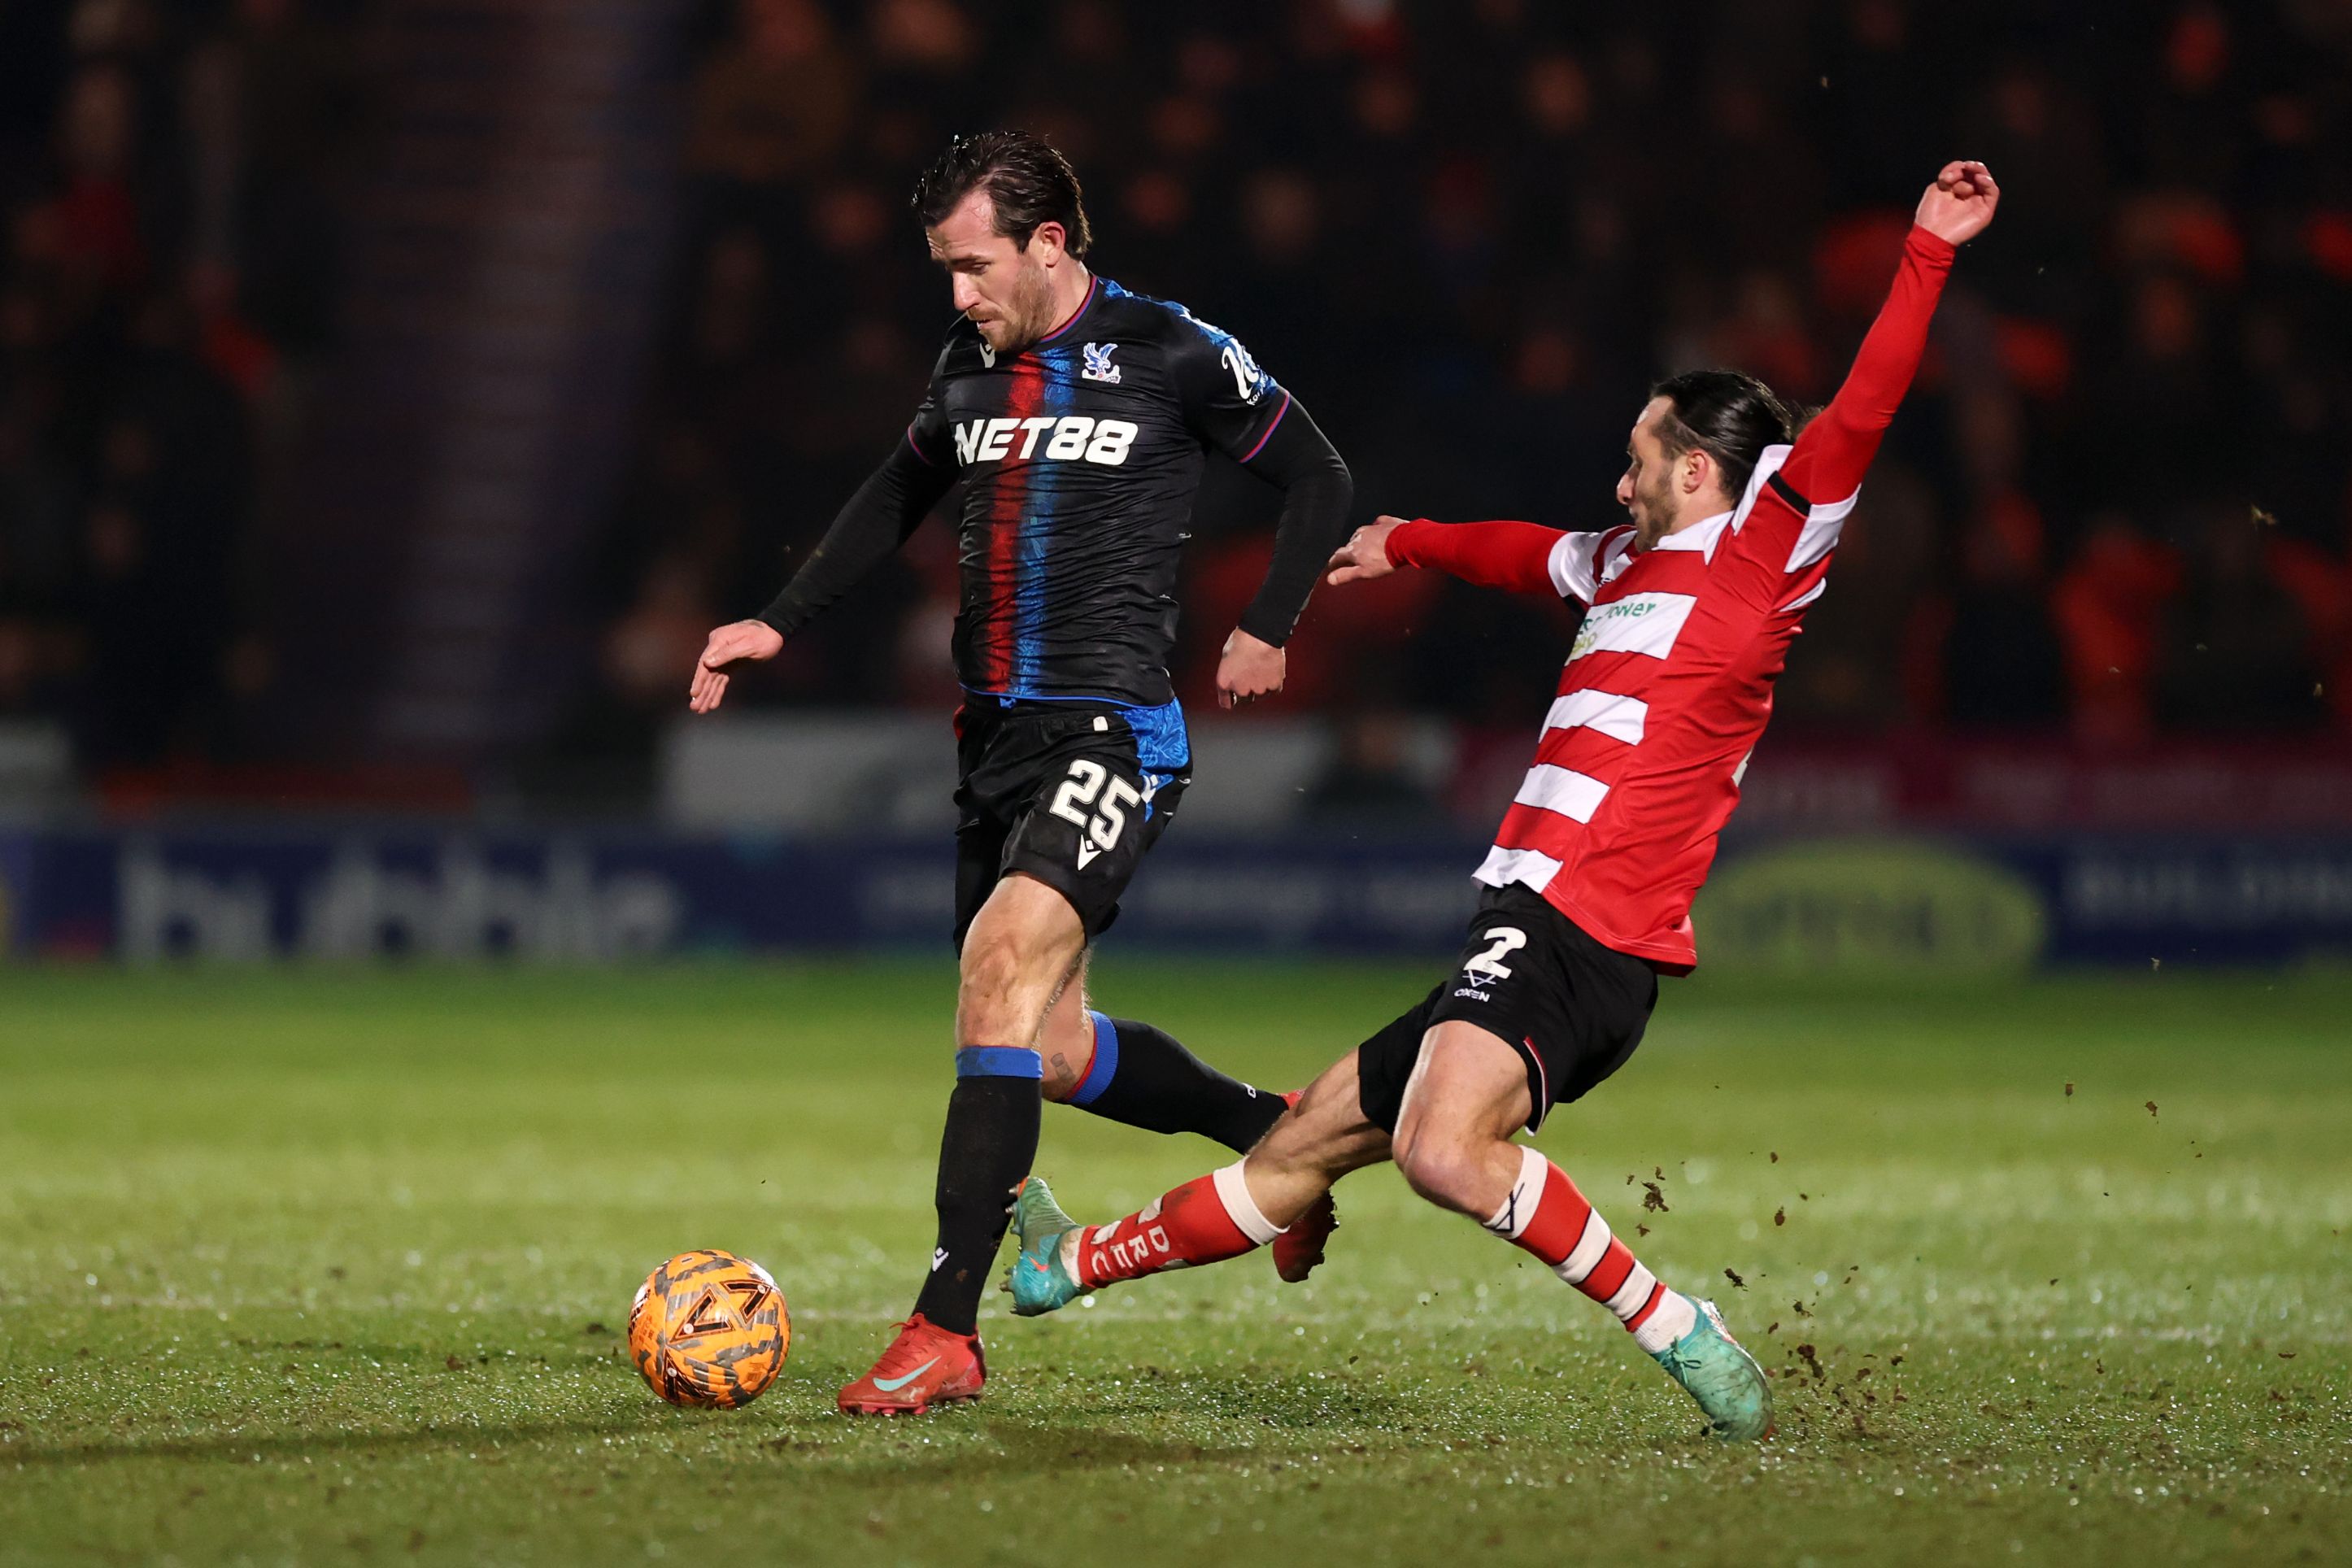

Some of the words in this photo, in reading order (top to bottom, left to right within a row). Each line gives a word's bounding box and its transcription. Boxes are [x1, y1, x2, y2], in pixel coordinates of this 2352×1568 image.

[955, 416, 1139, 467] NET88
[1049, 758, 1141, 852] 25
[1463, 926, 1527, 979] 2
[1454, 987, 1490, 1003] OXEN
